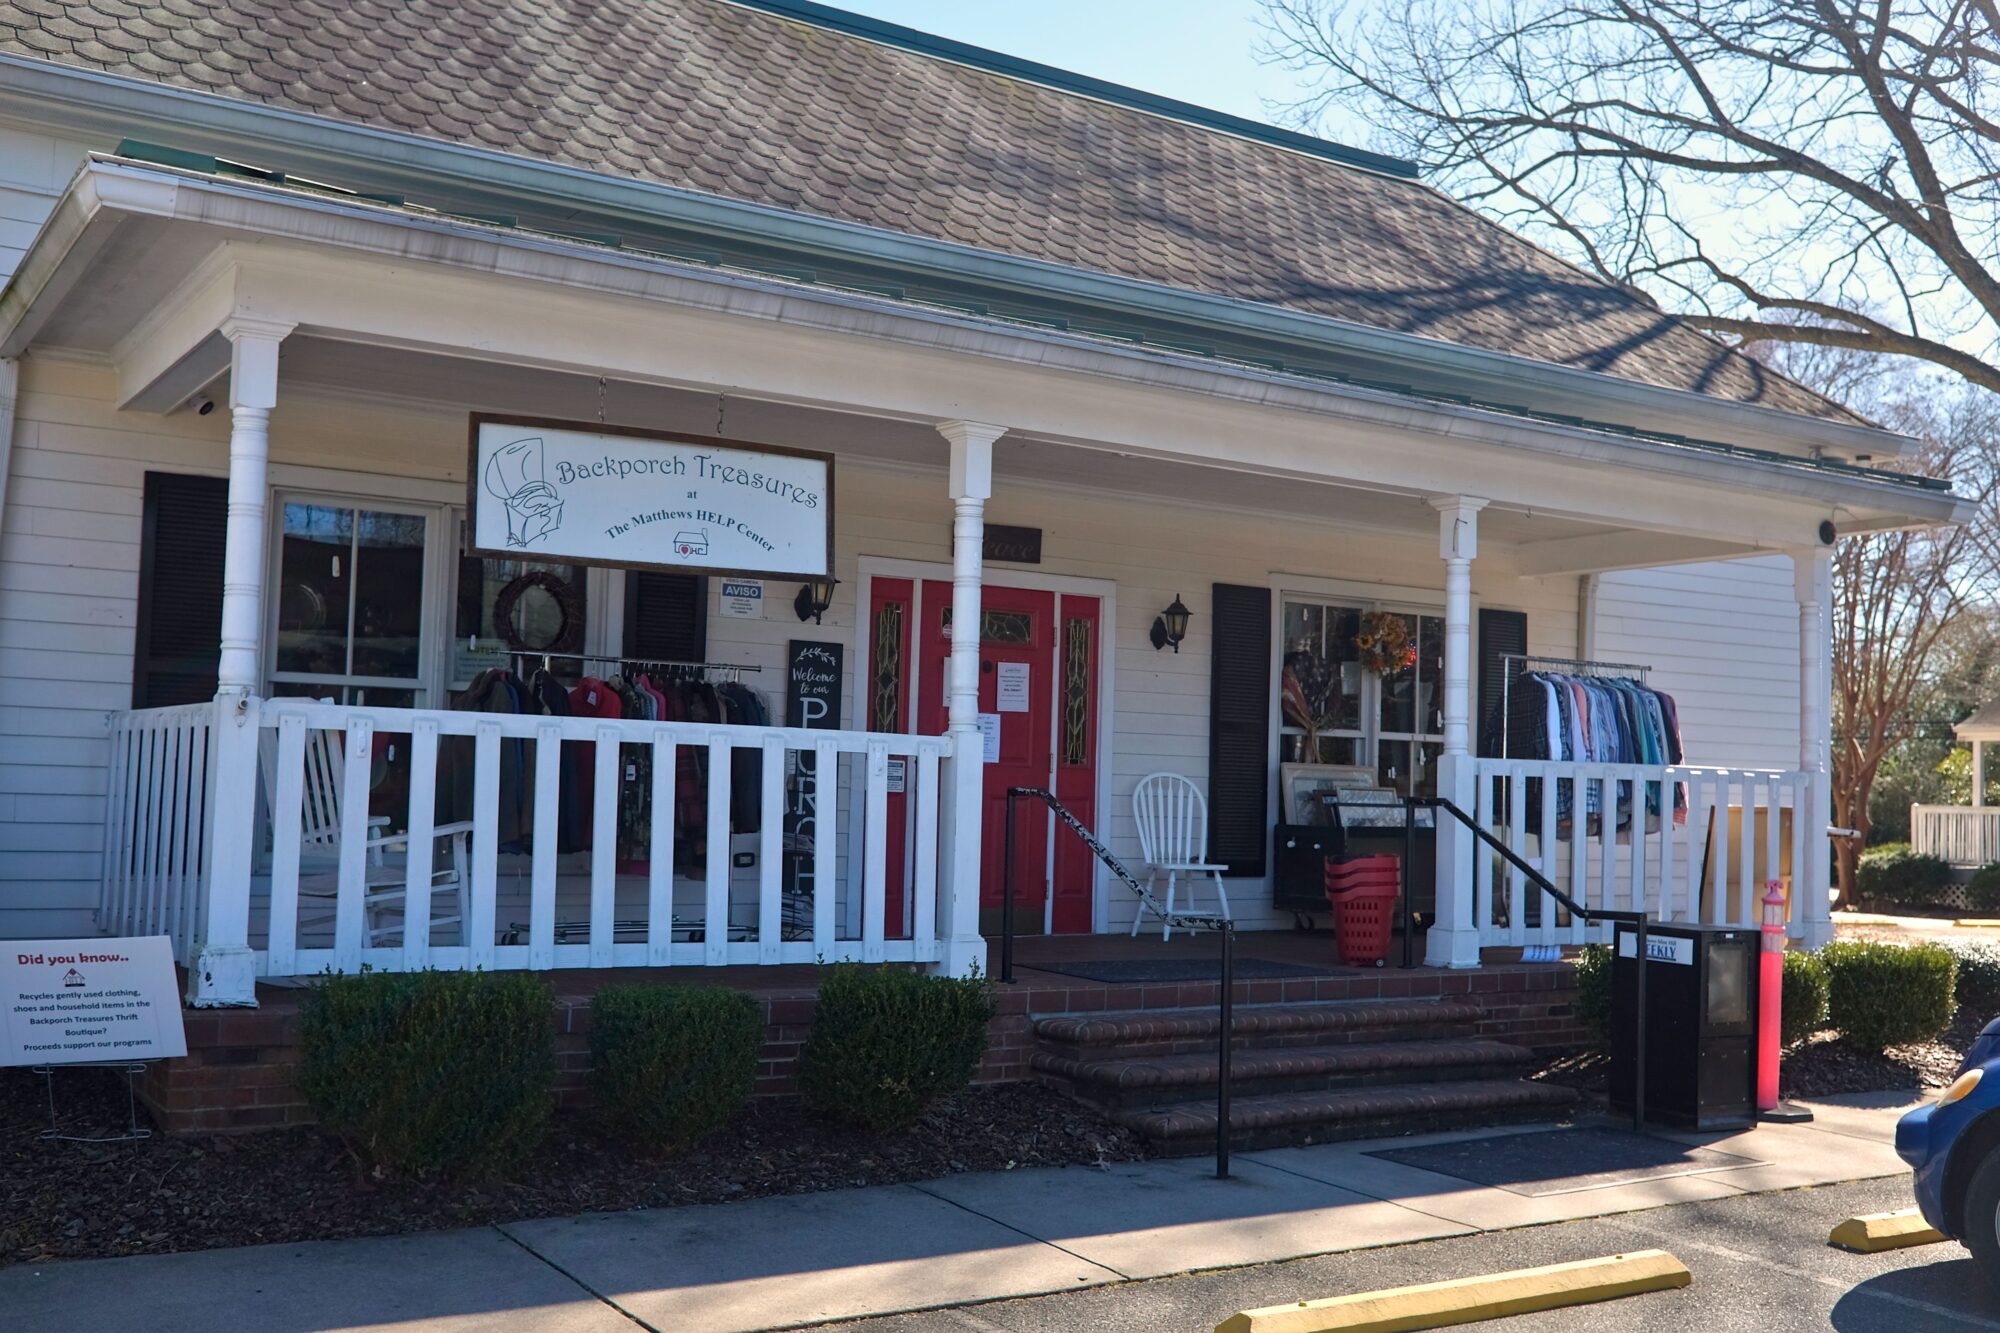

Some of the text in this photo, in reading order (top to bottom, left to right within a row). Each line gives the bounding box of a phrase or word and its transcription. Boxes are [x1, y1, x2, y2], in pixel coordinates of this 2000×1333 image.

[556, 454, 818, 509] Backporch Treasures
[686, 490, 698, 499] at
[605, 509, 775, 552] The Matthews HELP Center
[725, 585, 759, 597] AVISO
[792, 667, 836, 682] Welcome
[800, 682, 829, 694] to our
[17, 954, 44, 965] Did
[48, 956, 75, 966] you
[19, 992, 54, 1000] Recycles
[56, 991, 81, 1000] gently
[84, 990, 103, 998] used
[57, 1002, 100, 1010] household
[102, 1001, 125, 1009] items
[30, 1013, 138, 1025] Backporch Treasures Thrift
[65, 1028, 107, 1036] Boutique?
[23, 1043, 62, 1051] Proceeds
[63, 1041, 95, 1049] support
[113, 1039, 152, 1047] programs
